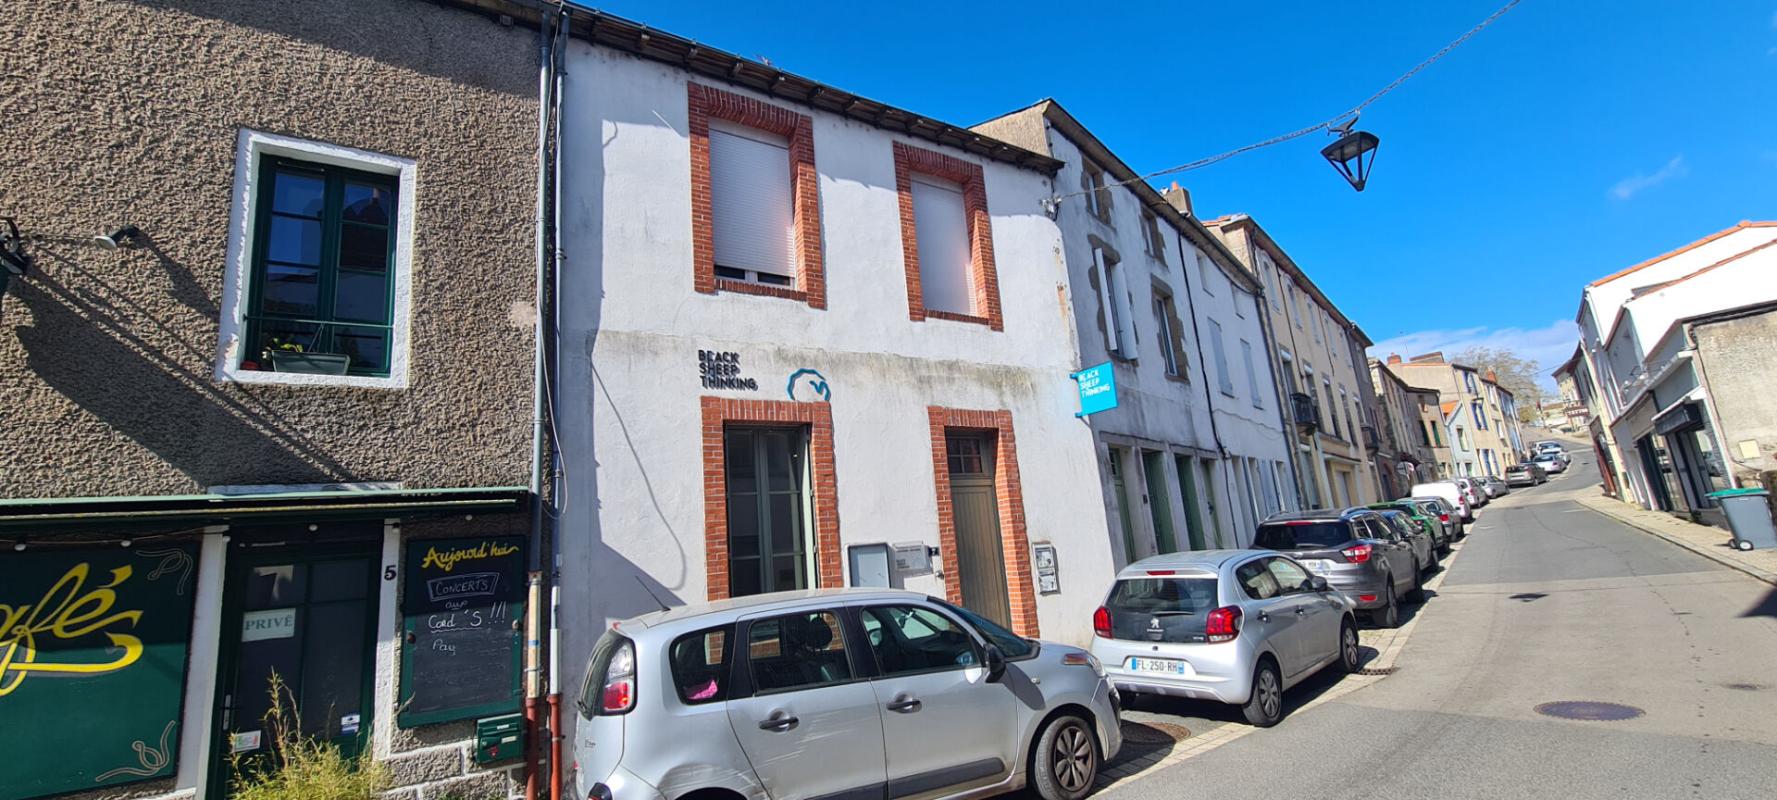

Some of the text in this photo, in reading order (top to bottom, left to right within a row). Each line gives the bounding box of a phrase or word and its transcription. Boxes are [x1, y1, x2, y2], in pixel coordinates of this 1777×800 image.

[698, 350, 740, 363] BLACK
[700, 363, 740, 376] SHEEP
[700, 376, 758, 391] THINKING
[384, 565, 397, 581] 5
[0, 562, 144, 696] afé
[244, 614, 294, 631] PRIVÉ
